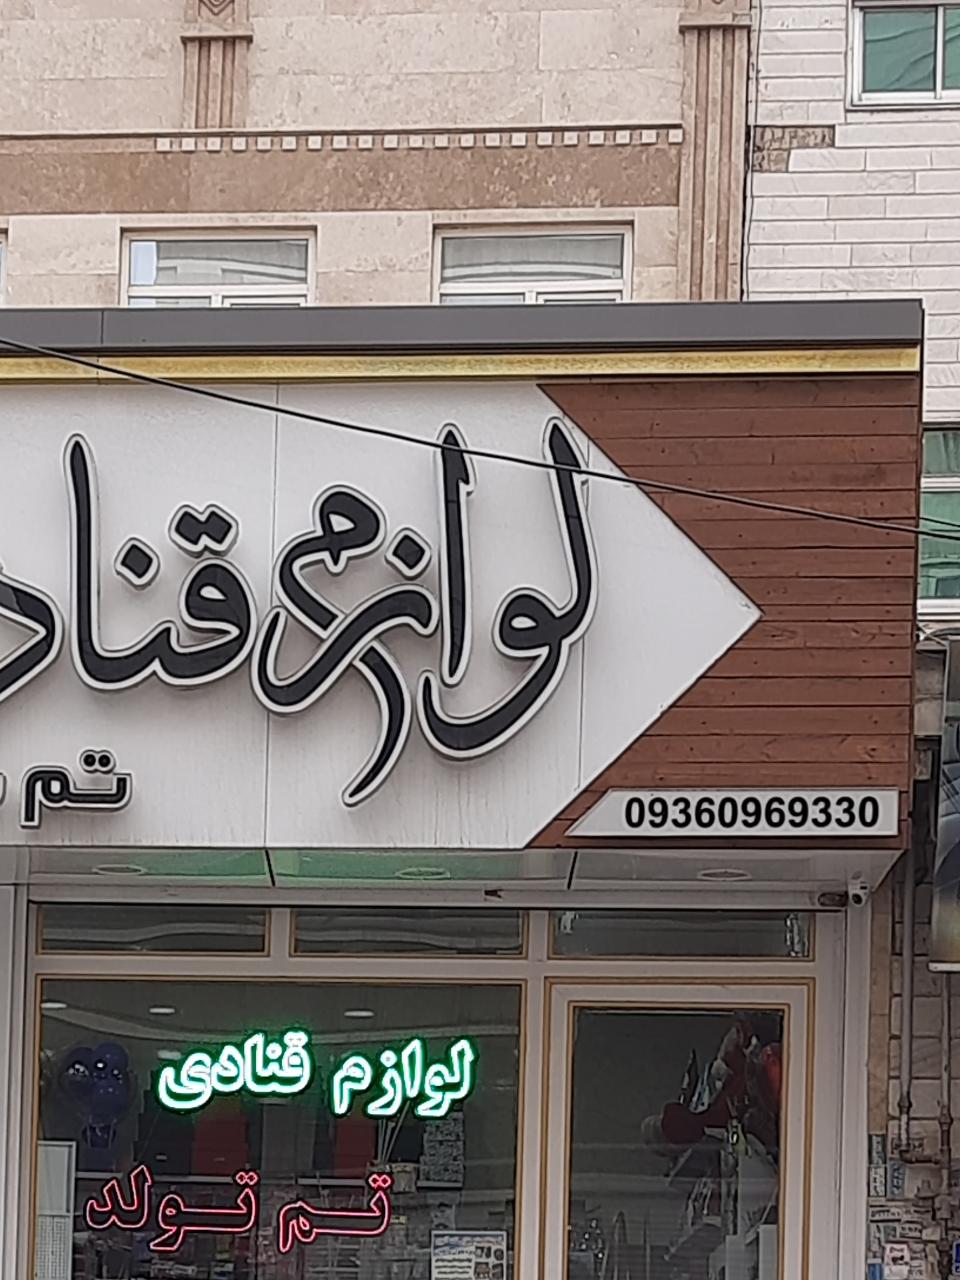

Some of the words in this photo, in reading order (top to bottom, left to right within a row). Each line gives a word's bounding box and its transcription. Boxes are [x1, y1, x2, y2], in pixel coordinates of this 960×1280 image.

[248, 415, 600, 808] لوازم
[18, 748, 131, 829] تم
[624, 794, 881, 829] 09360969330
[157, 1030, 313, 1110] قنادی
[331, 1038, 476, 1117] لوازم
[86, 1165, 258, 1253] تولد
[279, 1173, 393, 1254] تم
